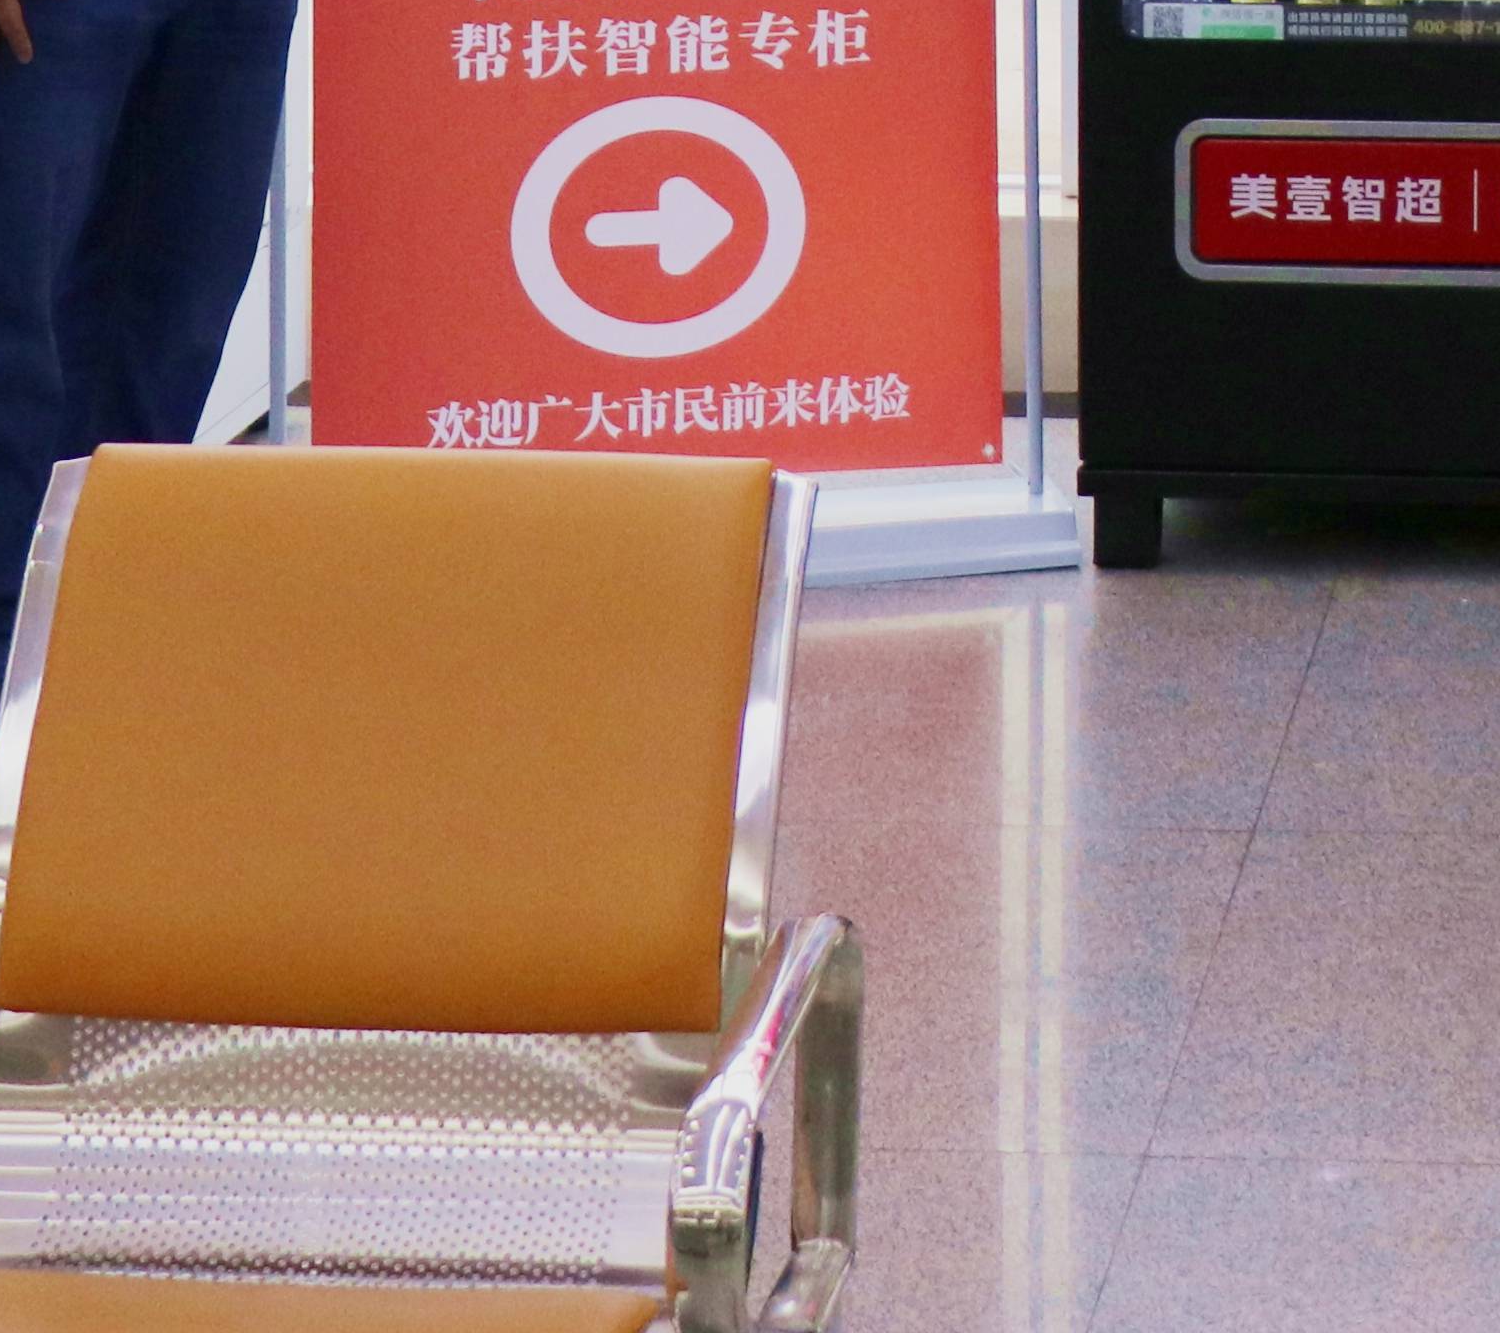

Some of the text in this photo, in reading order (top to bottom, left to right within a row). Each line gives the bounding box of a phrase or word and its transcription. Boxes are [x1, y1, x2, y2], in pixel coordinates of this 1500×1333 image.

[450, 8, 874, 83] 帮扶智能专柜
[1229, 172, 1444, 224] 美壹智超
[425, 371, 912, 450] 欢迎广大市民前来体验
